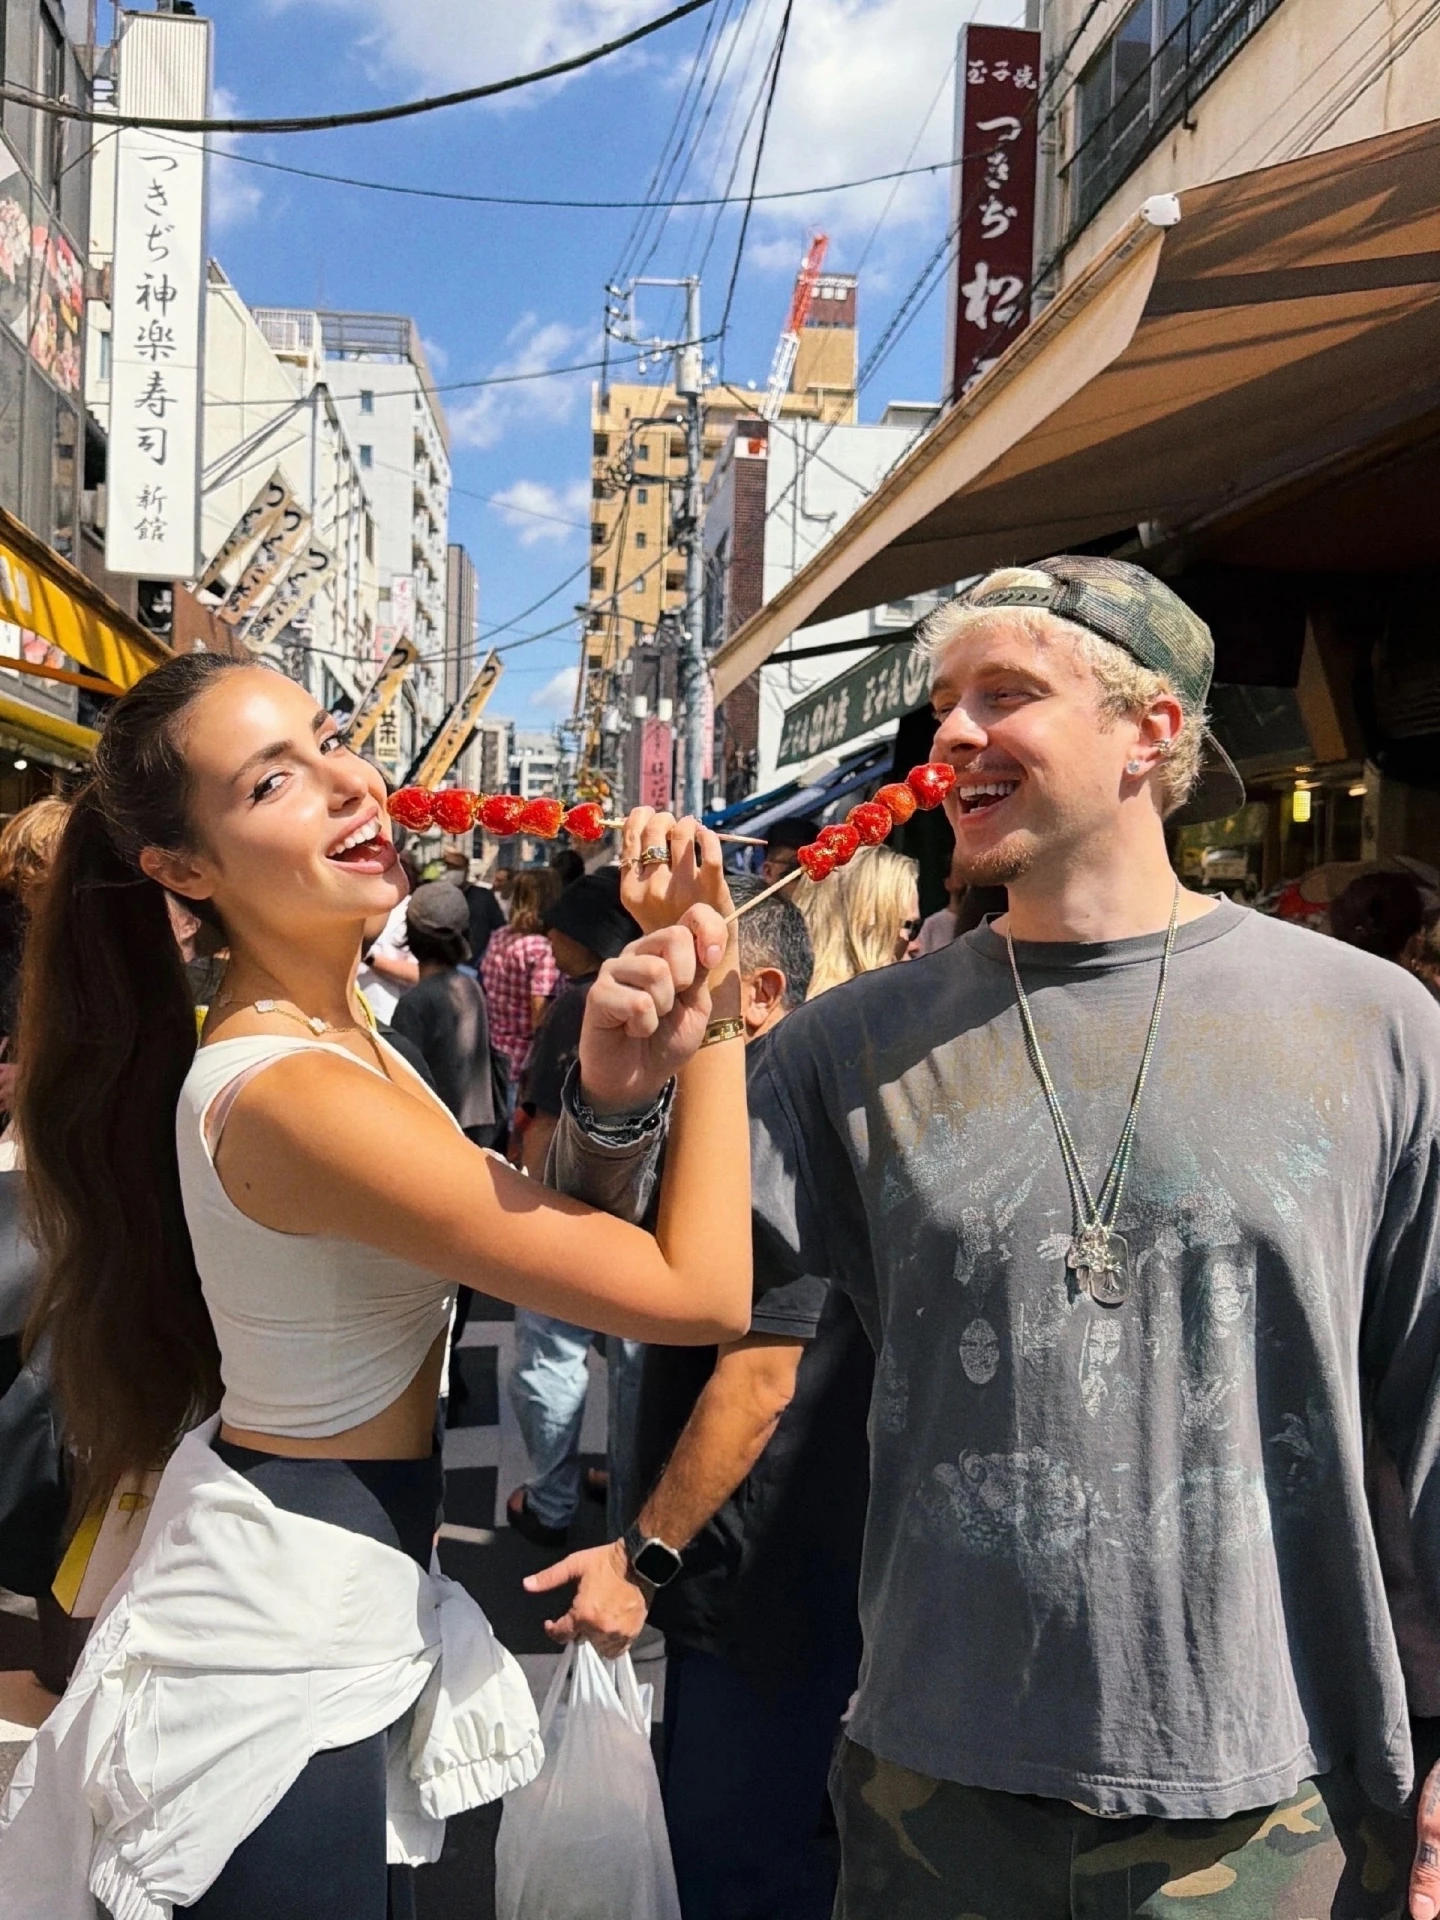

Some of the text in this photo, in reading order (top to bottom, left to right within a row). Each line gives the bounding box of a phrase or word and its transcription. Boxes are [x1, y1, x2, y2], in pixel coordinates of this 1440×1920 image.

[134, 154, 178, 543] つきぢ神楽寿司 新館
[380, 709, 397, 745] 茶
